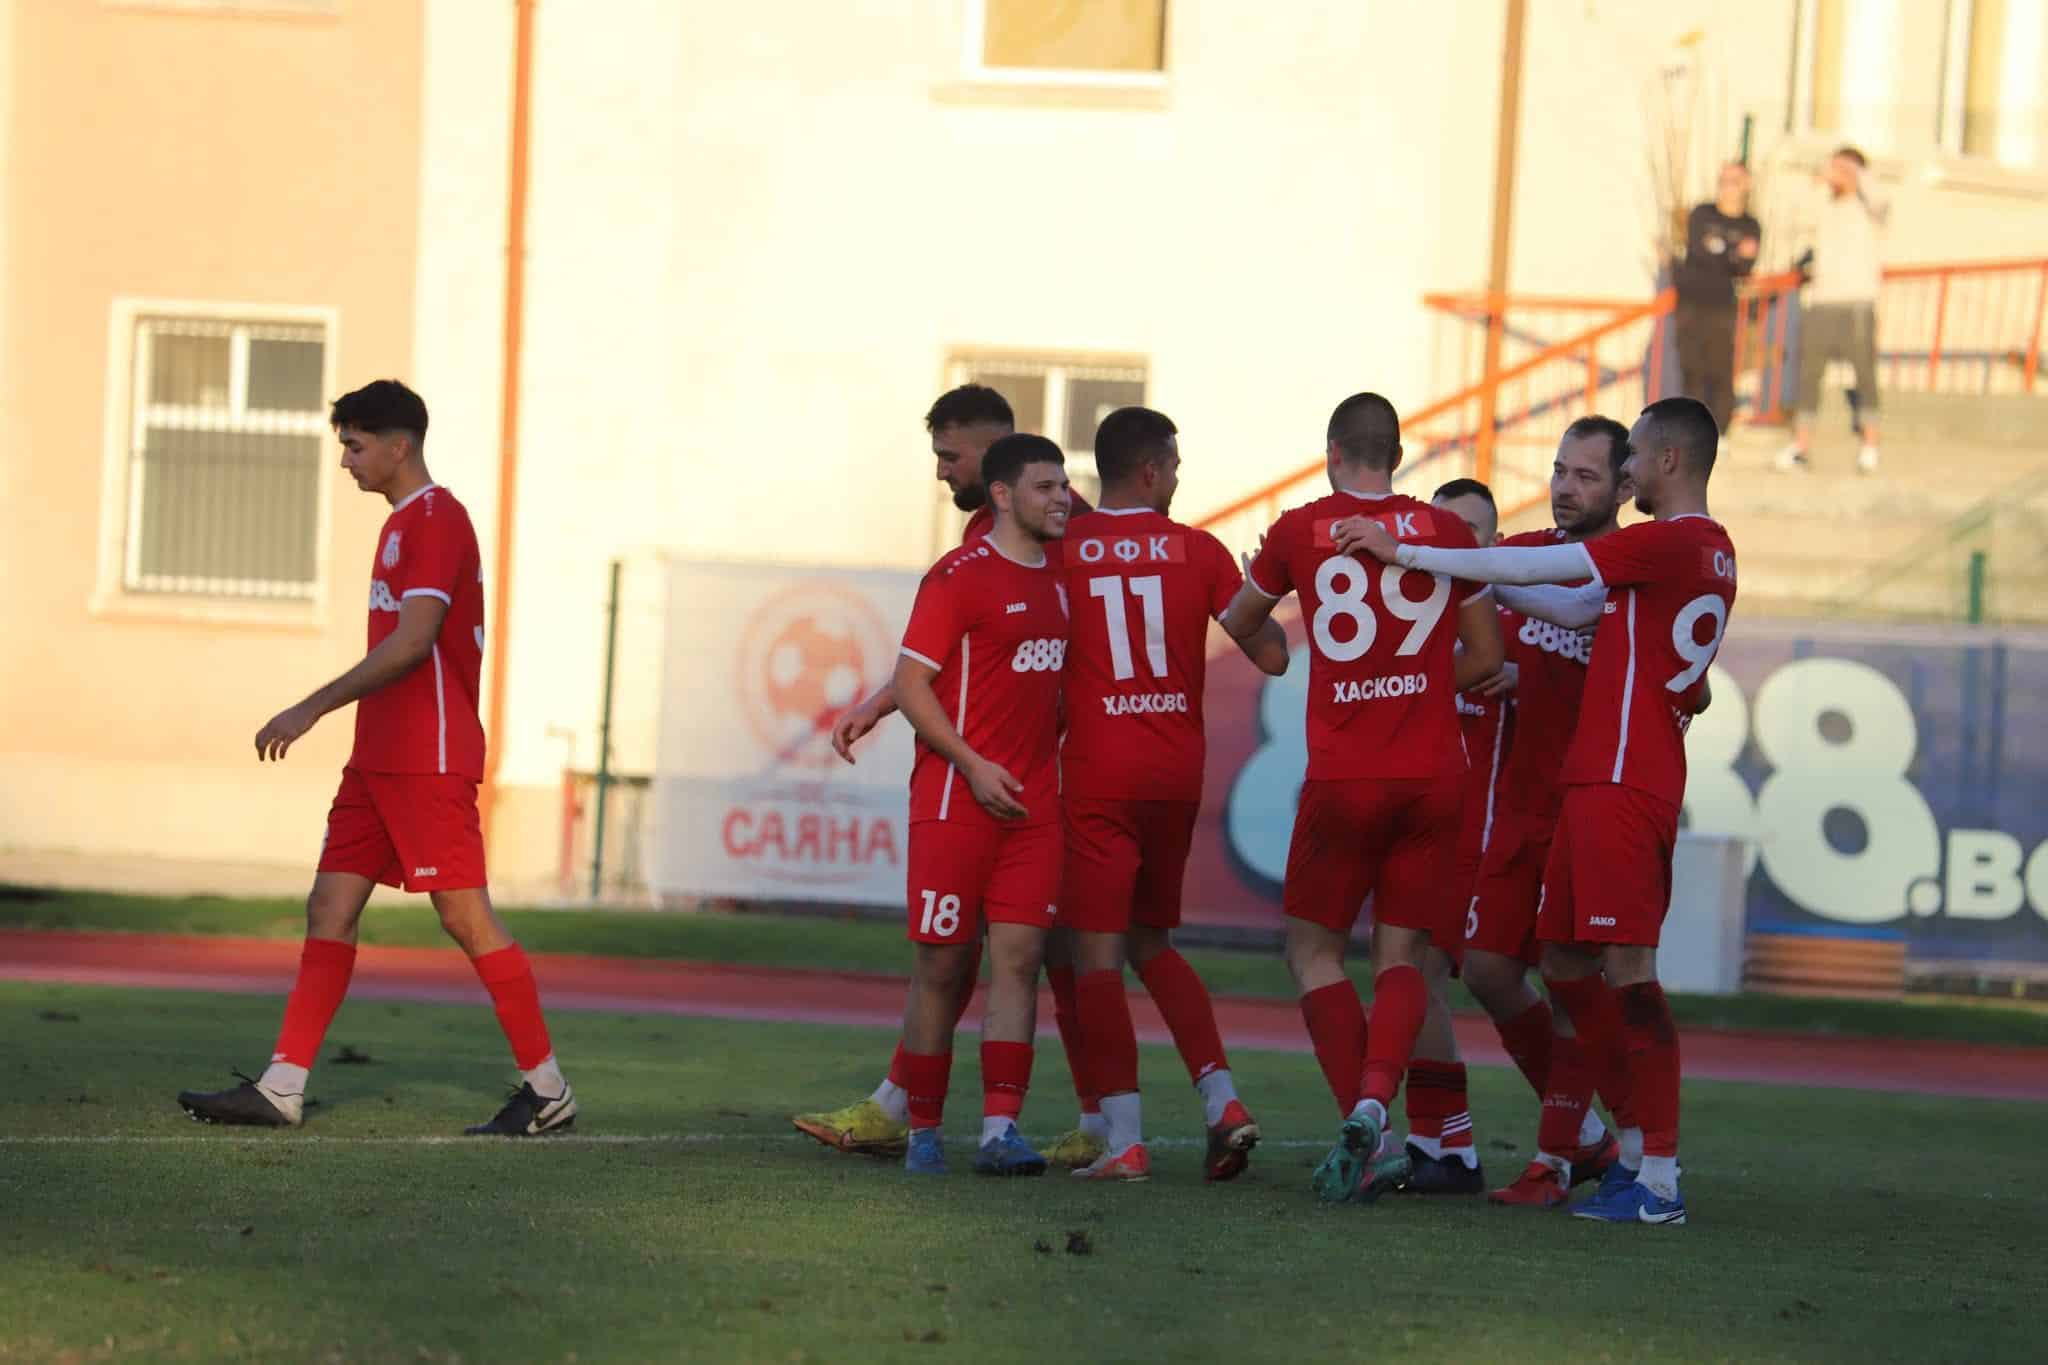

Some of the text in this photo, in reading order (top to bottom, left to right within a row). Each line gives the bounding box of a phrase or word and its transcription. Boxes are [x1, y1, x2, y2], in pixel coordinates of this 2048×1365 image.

[1089, 574, 1169, 681] 11
[1312, 554, 1452, 662] 89
[1012, 638, 1068, 673] 888
[1665, 593, 1726, 694] 9
[1103, 692, 1187, 716] ХАСКОВО
[1333, 673, 1427, 703] ХАСКОВО
[721, 806, 900, 869] САЯНА
[919, 889, 961, 937] 18
[1589, 915, 1617, 927] JAKO
